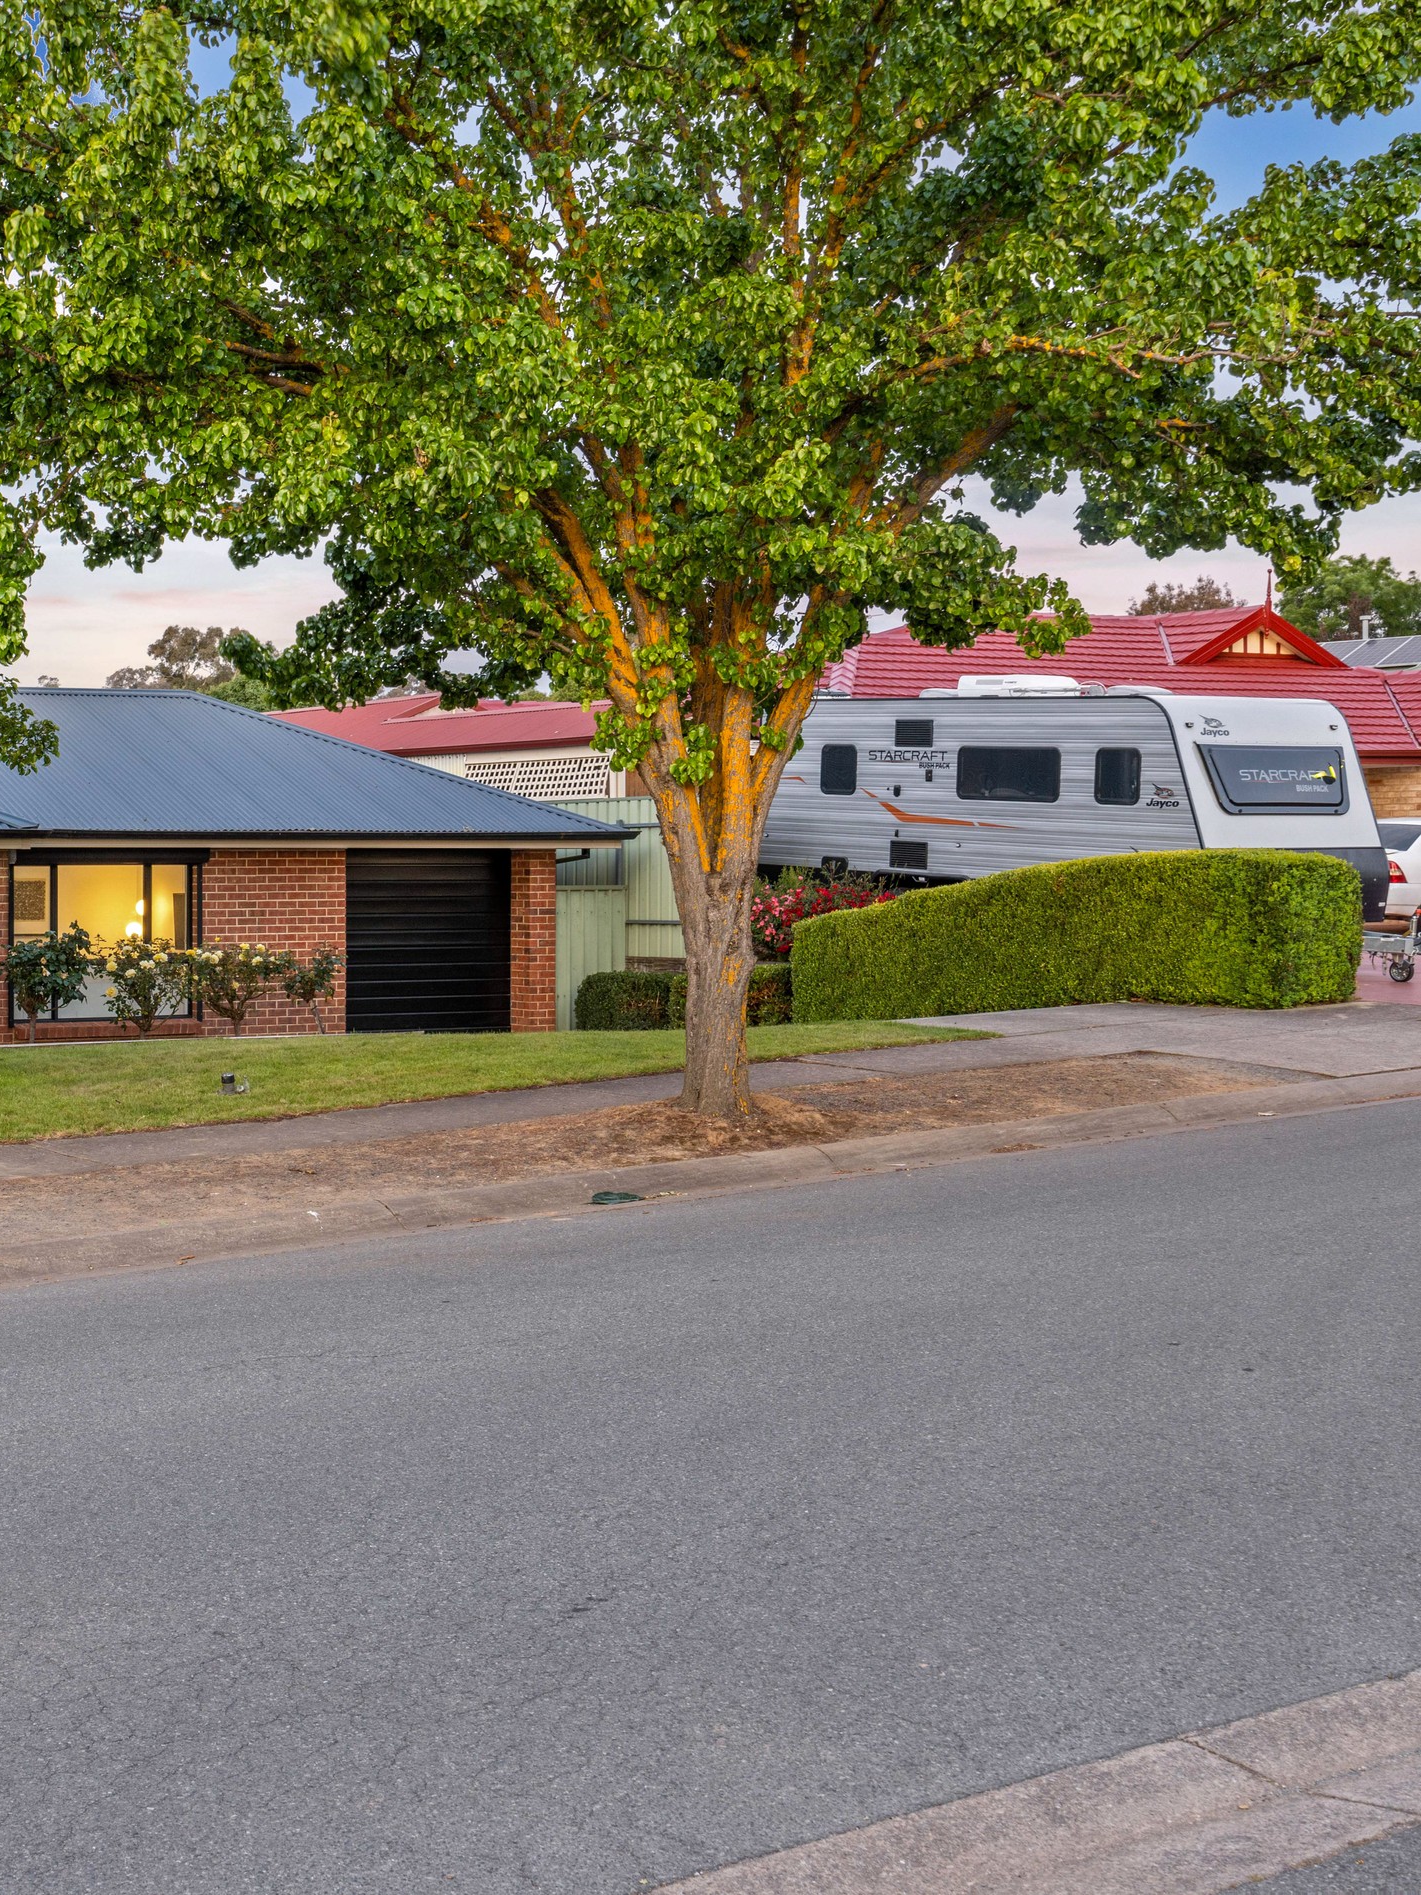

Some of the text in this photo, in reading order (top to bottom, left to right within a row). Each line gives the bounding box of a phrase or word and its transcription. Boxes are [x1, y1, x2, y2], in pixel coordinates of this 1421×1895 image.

[1200, 727, 1230, 738] Jayco
[868, 750, 948, 761] STARCRAFT
[1296, 784, 1329, 793] BUSH PACK
[1145, 798, 1180, 809] Jayco
